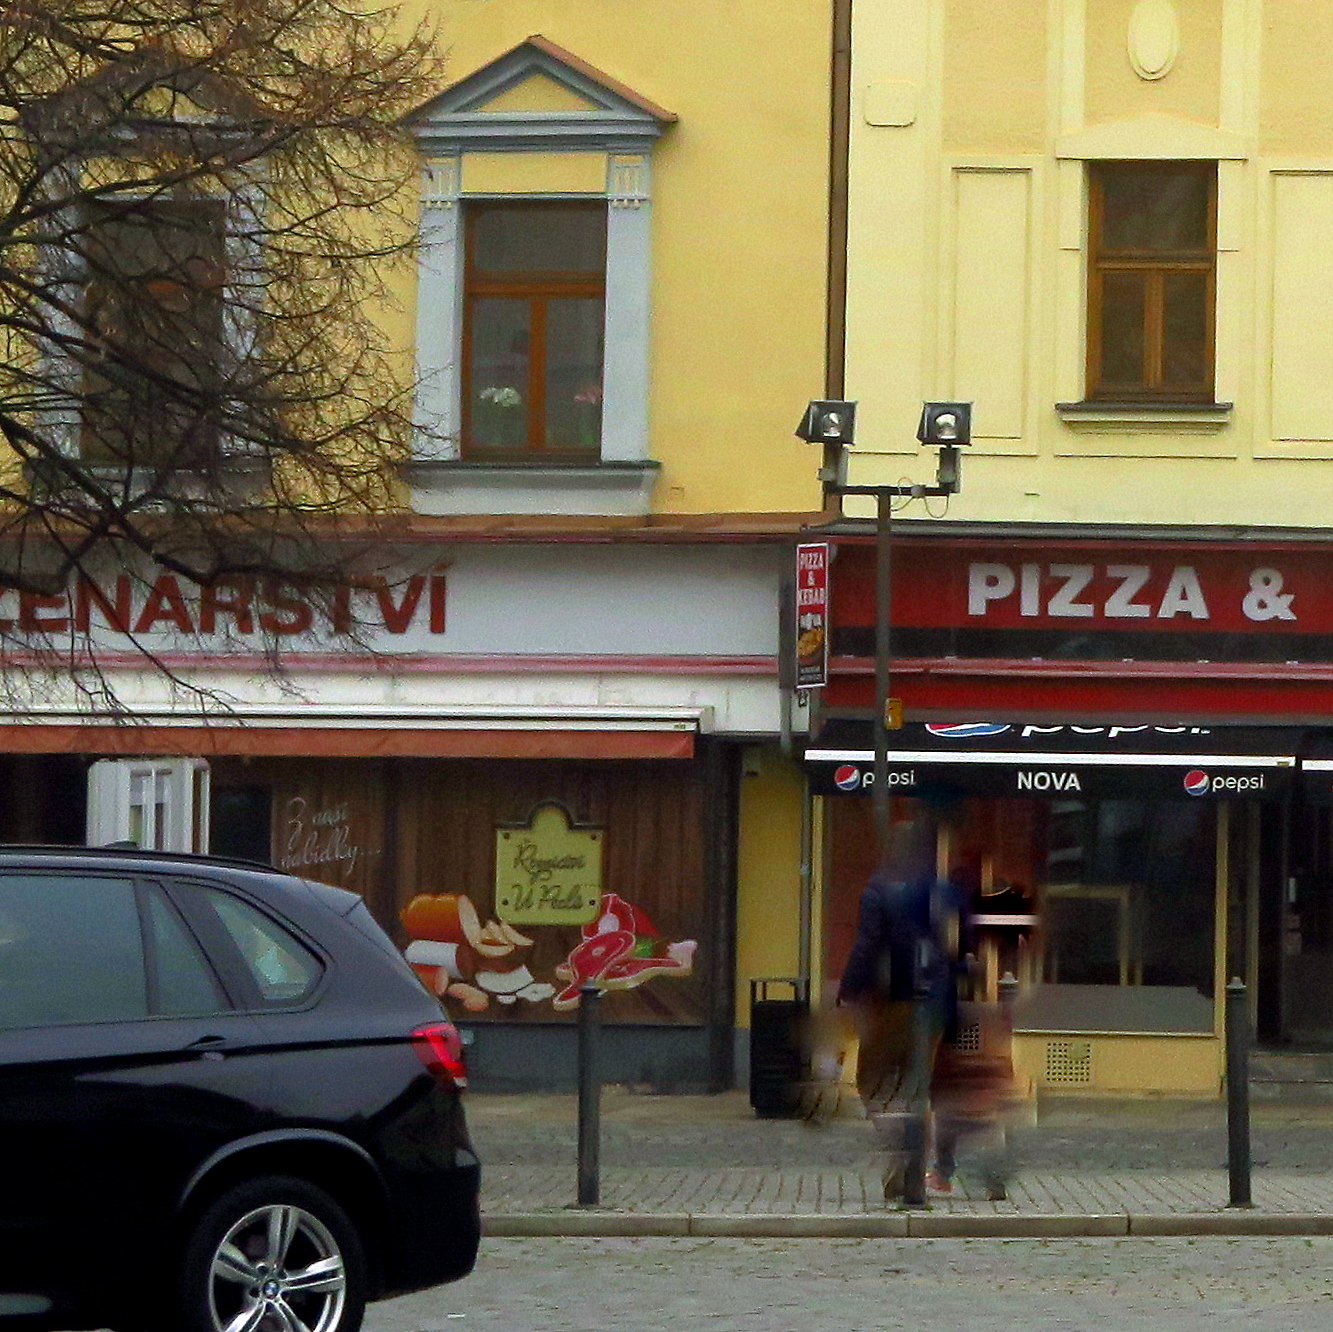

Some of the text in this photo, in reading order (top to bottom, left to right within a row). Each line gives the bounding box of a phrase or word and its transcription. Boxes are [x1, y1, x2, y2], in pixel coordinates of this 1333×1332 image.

[968, 562, 1210, 618] PIZZA
[1242, 568, 1298, 621] &
[862, 769, 916, 789] ppsi
[1017, 771, 1082, 791] NOVA
[1212, 773, 1265, 792] pepsi
